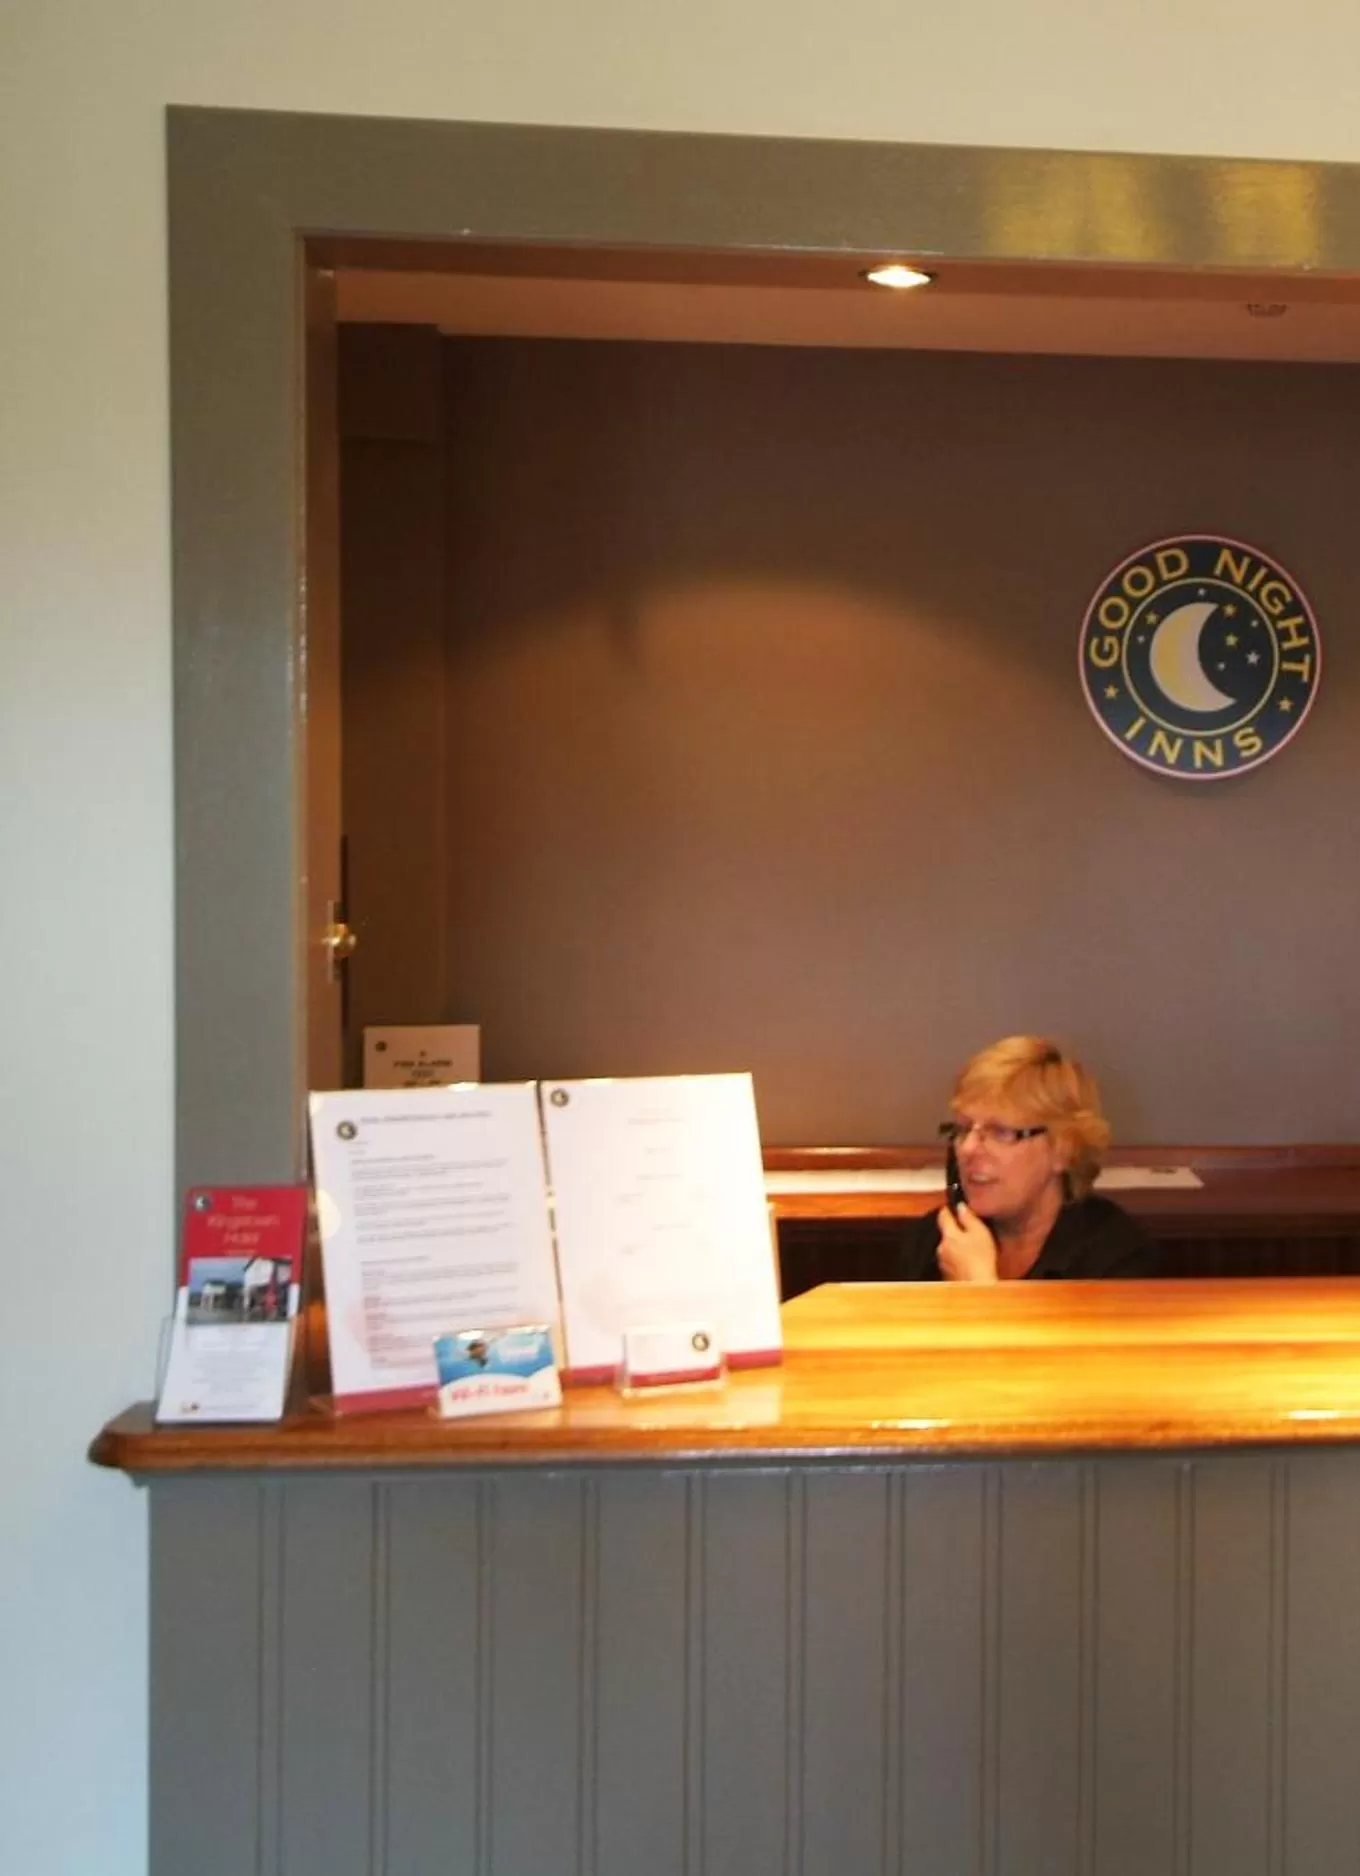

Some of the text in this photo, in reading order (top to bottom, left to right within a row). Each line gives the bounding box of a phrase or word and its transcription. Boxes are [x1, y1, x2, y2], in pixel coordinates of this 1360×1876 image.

[1090, 549, 1311, 683] GOOD NIGHT
[1124, 716, 1263, 768] INNS
